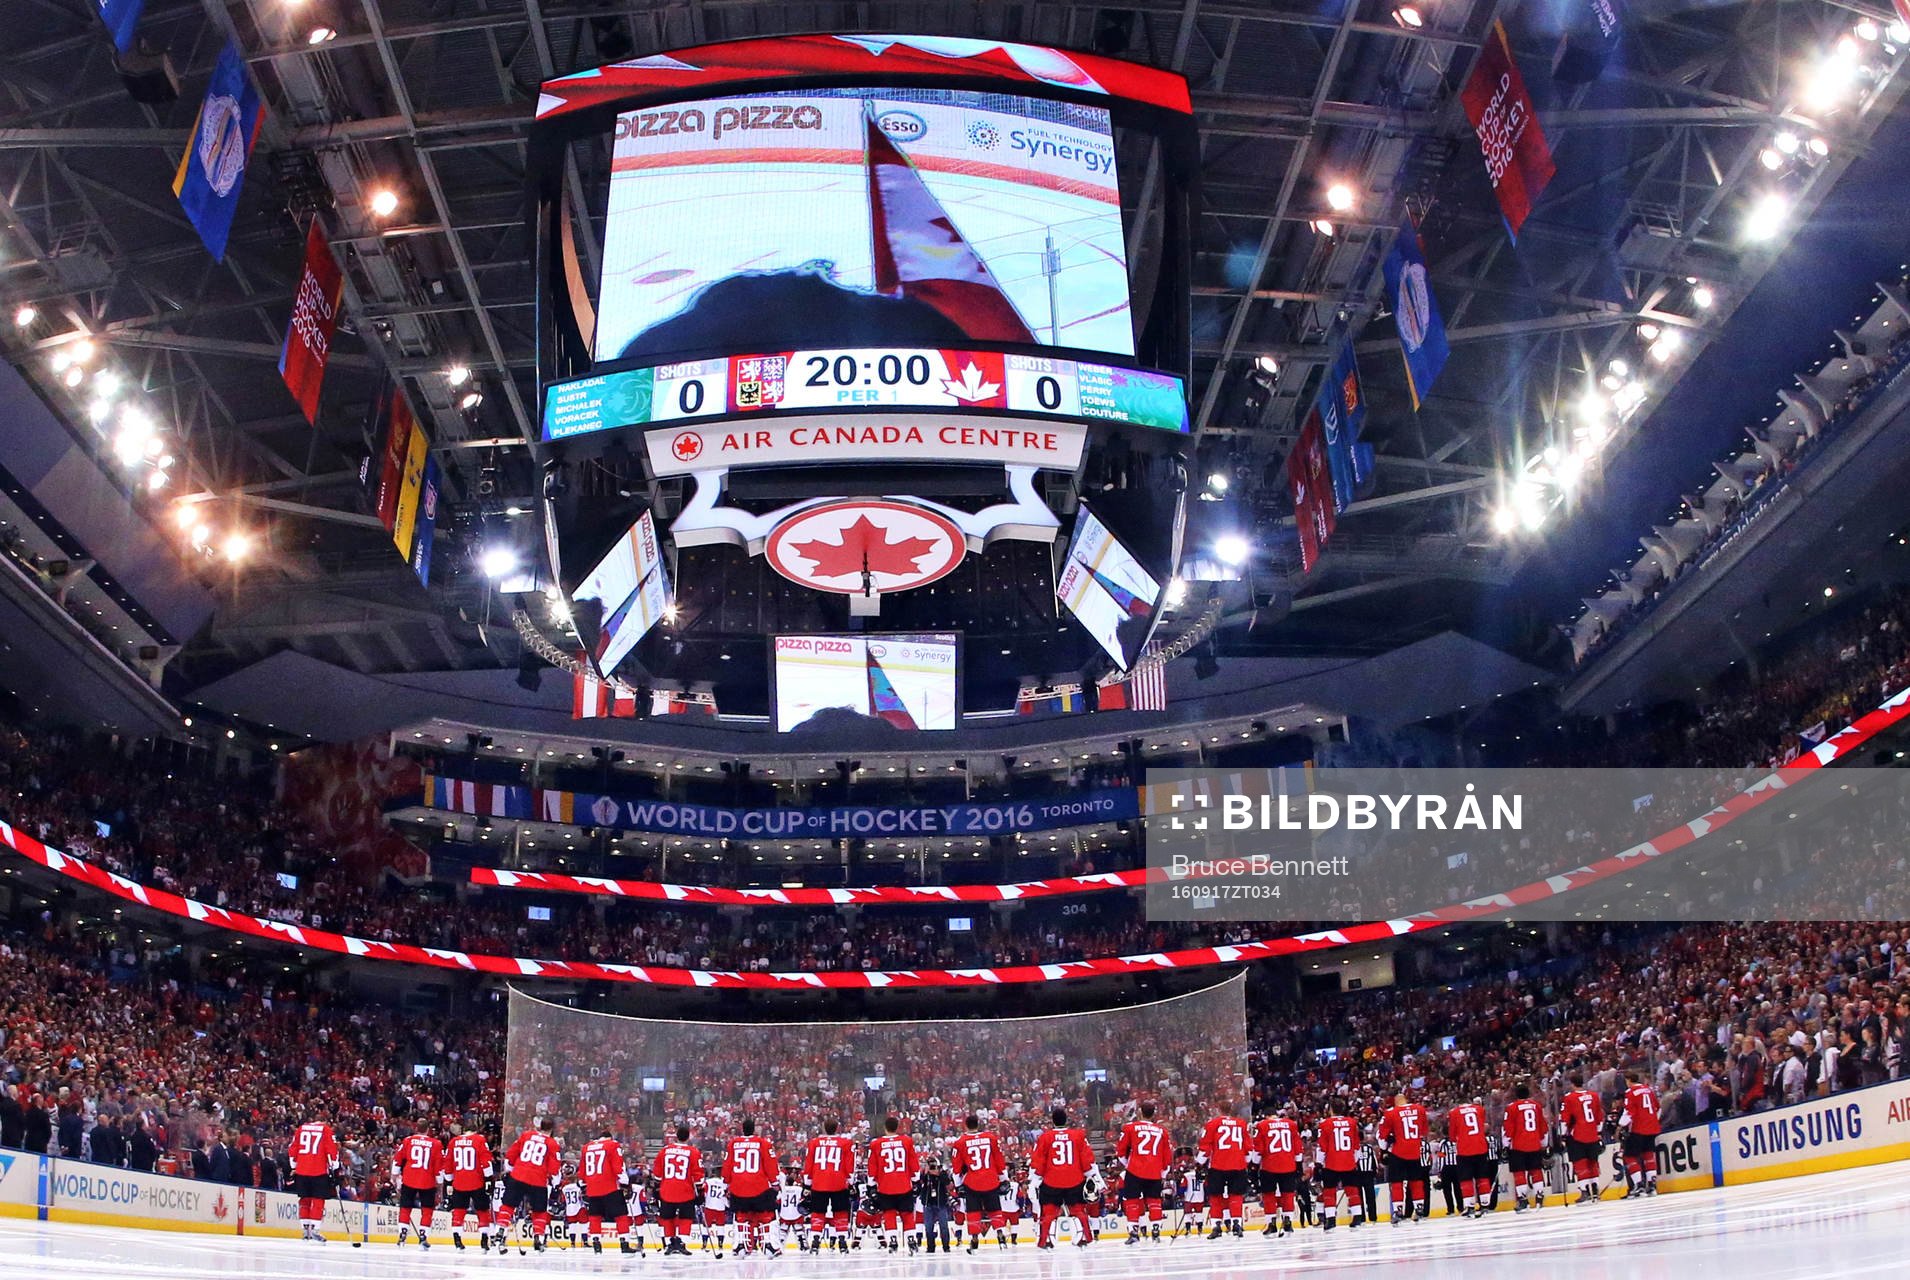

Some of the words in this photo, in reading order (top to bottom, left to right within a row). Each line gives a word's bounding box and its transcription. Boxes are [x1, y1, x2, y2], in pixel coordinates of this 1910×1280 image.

[1476, 73, 1509, 140] WORLD
[713, 106, 822, 140] pizza
[1028, 128, 1049, 138] FUEL
[1055, 133, 1112, 152] TECHNOLOGY
[1482, 117, 1499, 155] CUP
[1485, 99, 1524, 173] HOCKEY
[1010, 130, 1113, 174] Synergy
[1490, 144, 1513, 189] 2016
[301, 280, 317, 307] CUP
[305, 268, 331, 320] WORLD
[292, 309, 311, 348] 2016
[297, 293, 327, 354] HOCKEY
[659, 364, 702, 379] SHOTS
[805, 355, 930, 387] 20:00
[1010, 357, 1052, 372] SHOTS
[557, 377, 606, 393] NAKLADAL
[679, 380, 704, 413] 0
[837, 390, 880, 402] PER
[1036, 376, 1062, 410] 0
[555, 399, 602, 414] MICHALEK
[557, 392, 587, 404] SUSTR
[1081, 396, 1116, 407] TOEWS
[554, 410, 599, 425] VORACEK
[1082, 406, 1129, 421] COUTURE
[553, 420, 602, 436] PLEKANEC
[722, 431, 773, 451] AIR
[790, 427, 923, 446] CANADA
[938, 427, 1058, 450] CENTRE
[776, 638, 812, 652] pizza
[815, 640, 852, 654] pizza
[914, 649, 952, 663] Synergy
[627, 802, 737, 833] WORLD
[743, 812, 804, 833] CUP
[808, 816, 826, 827] OF
[830, 808, 959, 832] HOCKEY
[966, 805, 1033, 829] 2016
[1041, 799, 1114, 818] TORONTO
[1062, 904, 1087, 915] 304
[1582, 1100, 1594, 1122] 6
[1642, 1094, 1653, 1114] 4
[1401, 1116, 1418, 1139] 15
[1464, 1112, 1479, 1135] 9
[1523, 1109, 1536, 1132] 8
[1737, 1104, 1862, 1159] SAMSUNG
[299, 1132, 322, 1154] 97
[1137, 1131, 1162, 1155] 27
[1217, 1126, 1243, 1150] 24
[1267, 1129, 1291, 1153] 20
[1333, 1128, 1351, 1151] 16
[411, 1146, 431, 1170] 91
[453, 1147, 476, 1170] 90
[520, 1140, 547, 1166] 88
[585, 1150, 606, 1176] 87
[733, 1149, 760, 1173] 50
[814, 1146, 842, 1171] 44
[881, 1148, 906, 1173] 39
[967, 1144, 991, 1171] 37
[1051, 1141, 1073, 1165] 31
[664, 1154, 689, 1180] 63
[54, 1173, 108, 1200] WORLD
[111, 1180, 138, 1203] CUP
[150, 1187, 200, 1210] HOCKEY
[277, 1203, 298, 1220] WOR
[332, 1208, 363, 1227] HOCKEY
